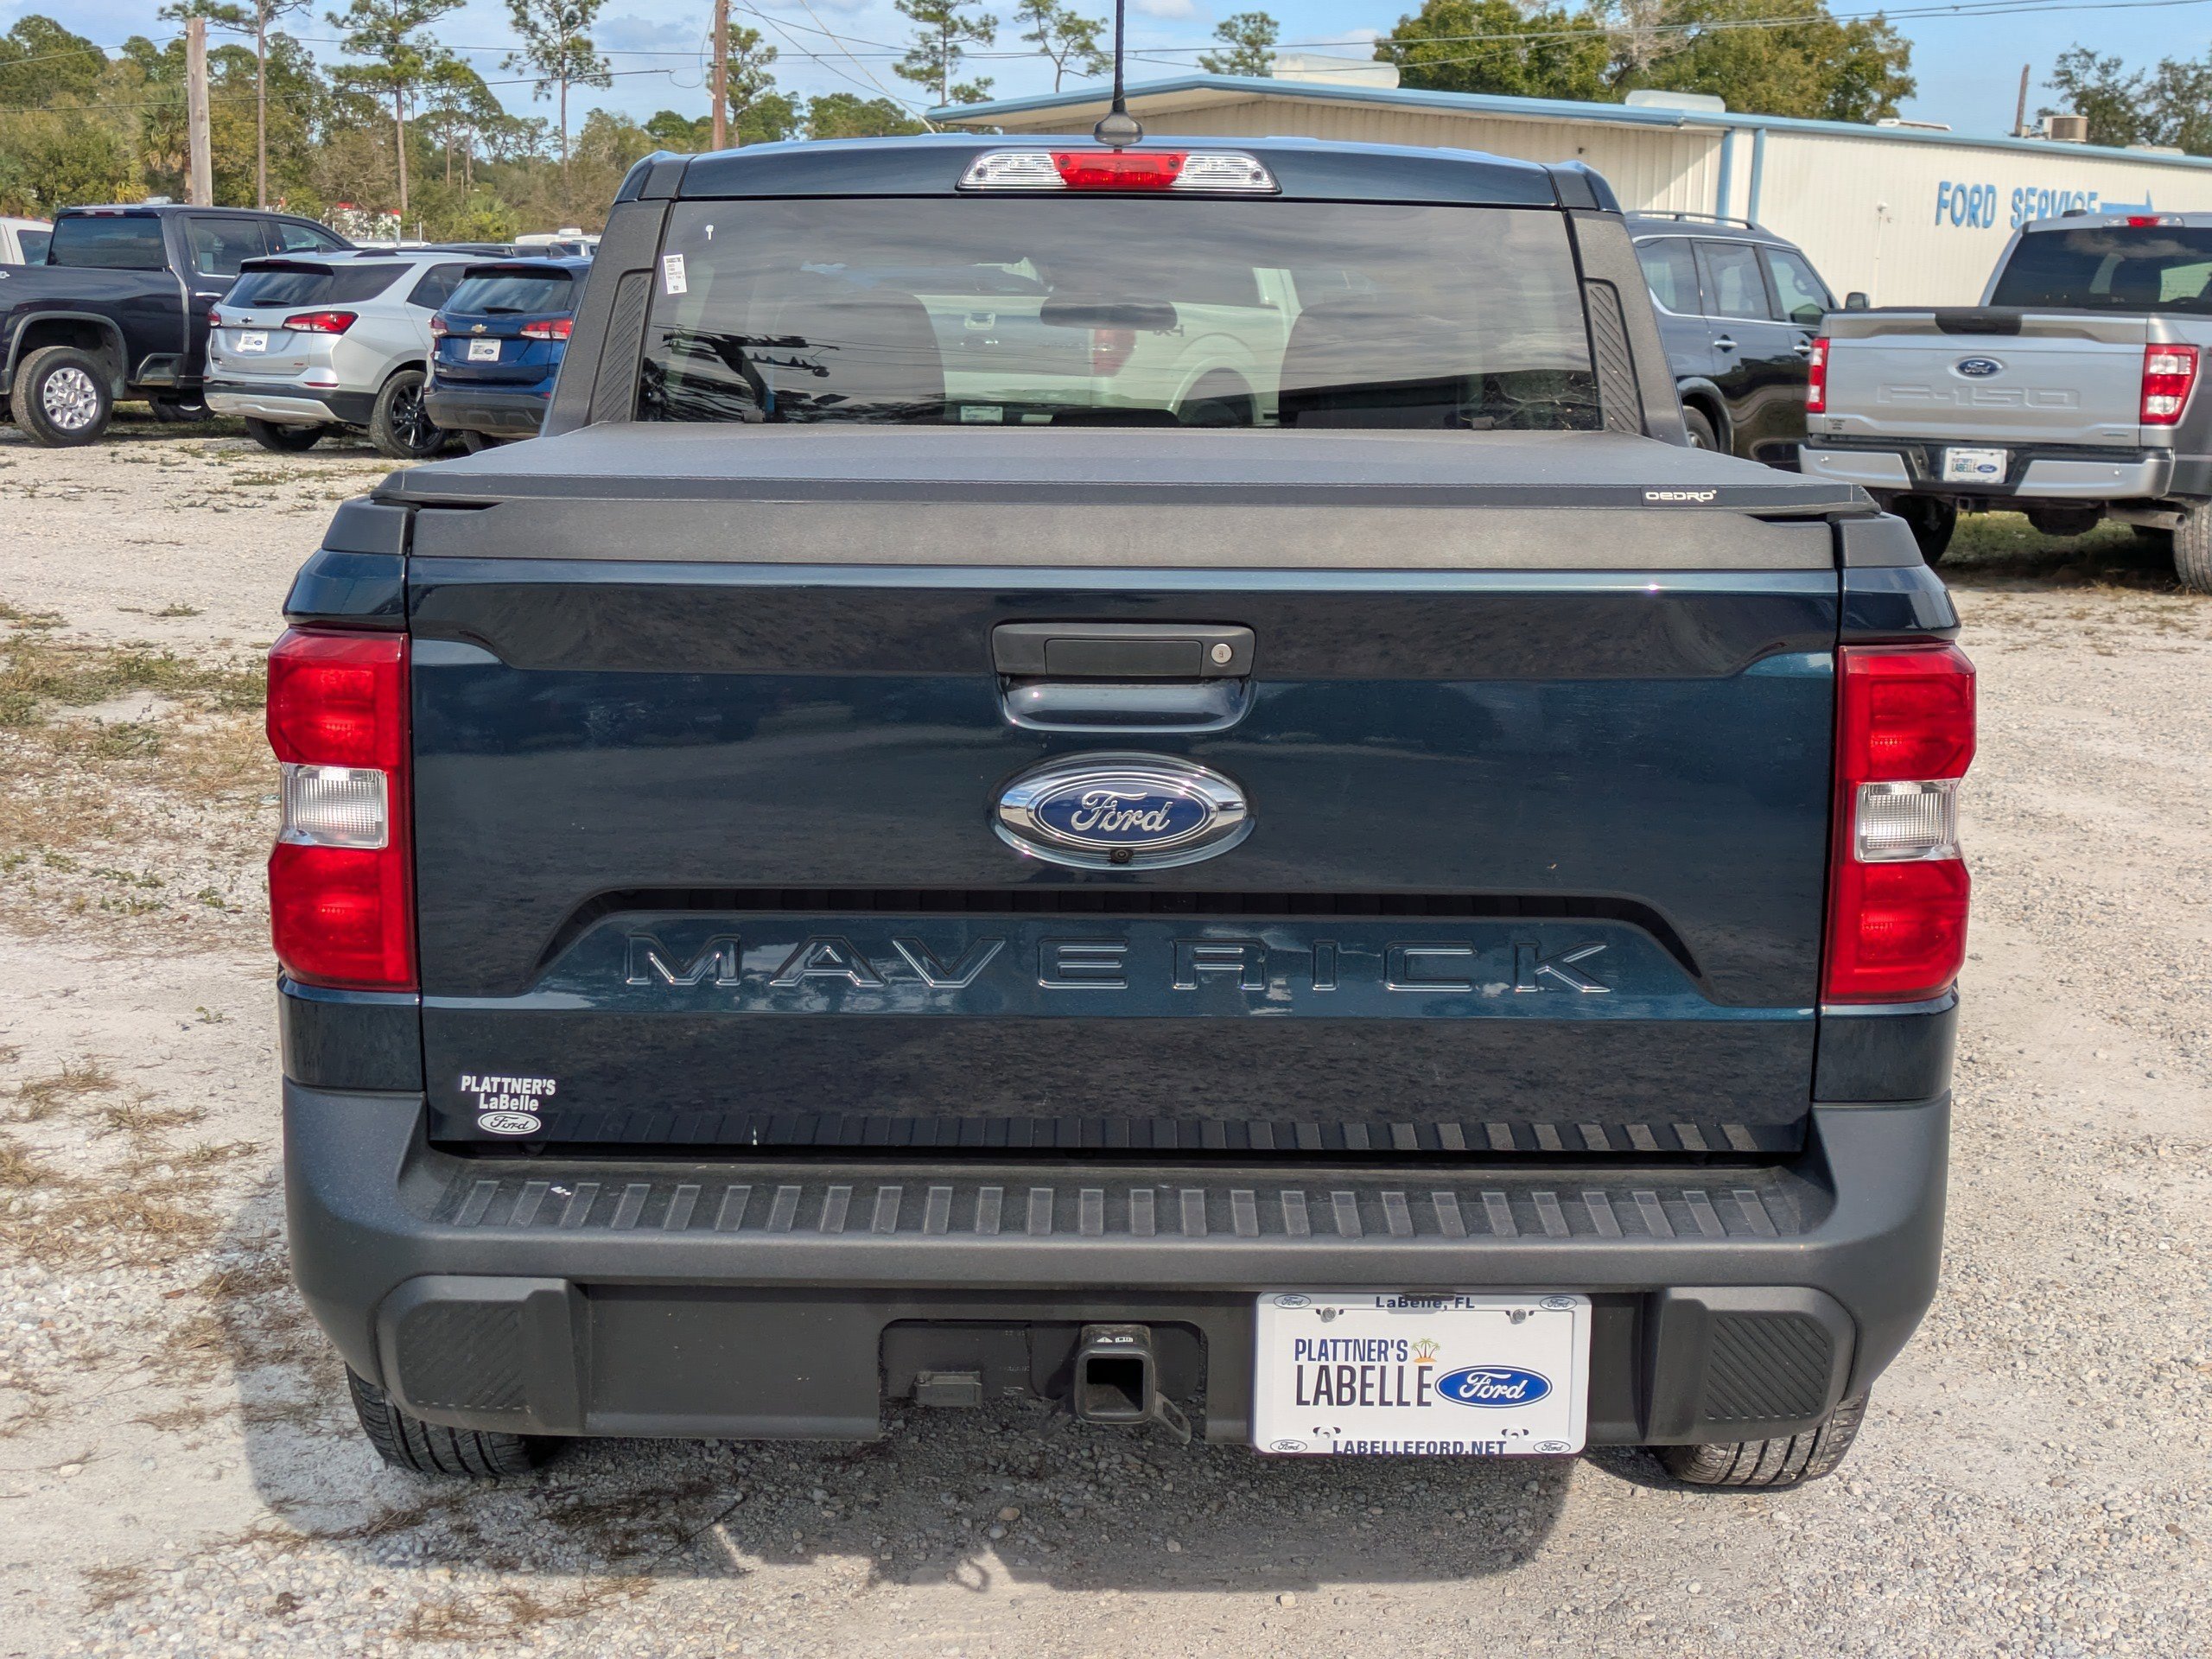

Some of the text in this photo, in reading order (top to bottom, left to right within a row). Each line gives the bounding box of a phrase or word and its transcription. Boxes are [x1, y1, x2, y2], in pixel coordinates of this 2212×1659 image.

[1936, 181, 1997, 229] FORD
[1877, 384, 2081, 410] F-150
[1071, 790, 1172, 832] Ford
[625, 934, 1611, 994] MAVERICK
[461, 1075, 556, 1096] PLATTNER'S
[479, 1093, 539, 1112] LaBelle
[490, 1115, 530, 1130] Ford
[1454, 1297, 1476, 1309] FL
[1294, 1338, 1408, 1363] PLATTNER'S
[1295, 1364, 1529, 1408] LABELLE Ford
[1332, 1440, 1507, 1455] LABELLEFORD.NET
